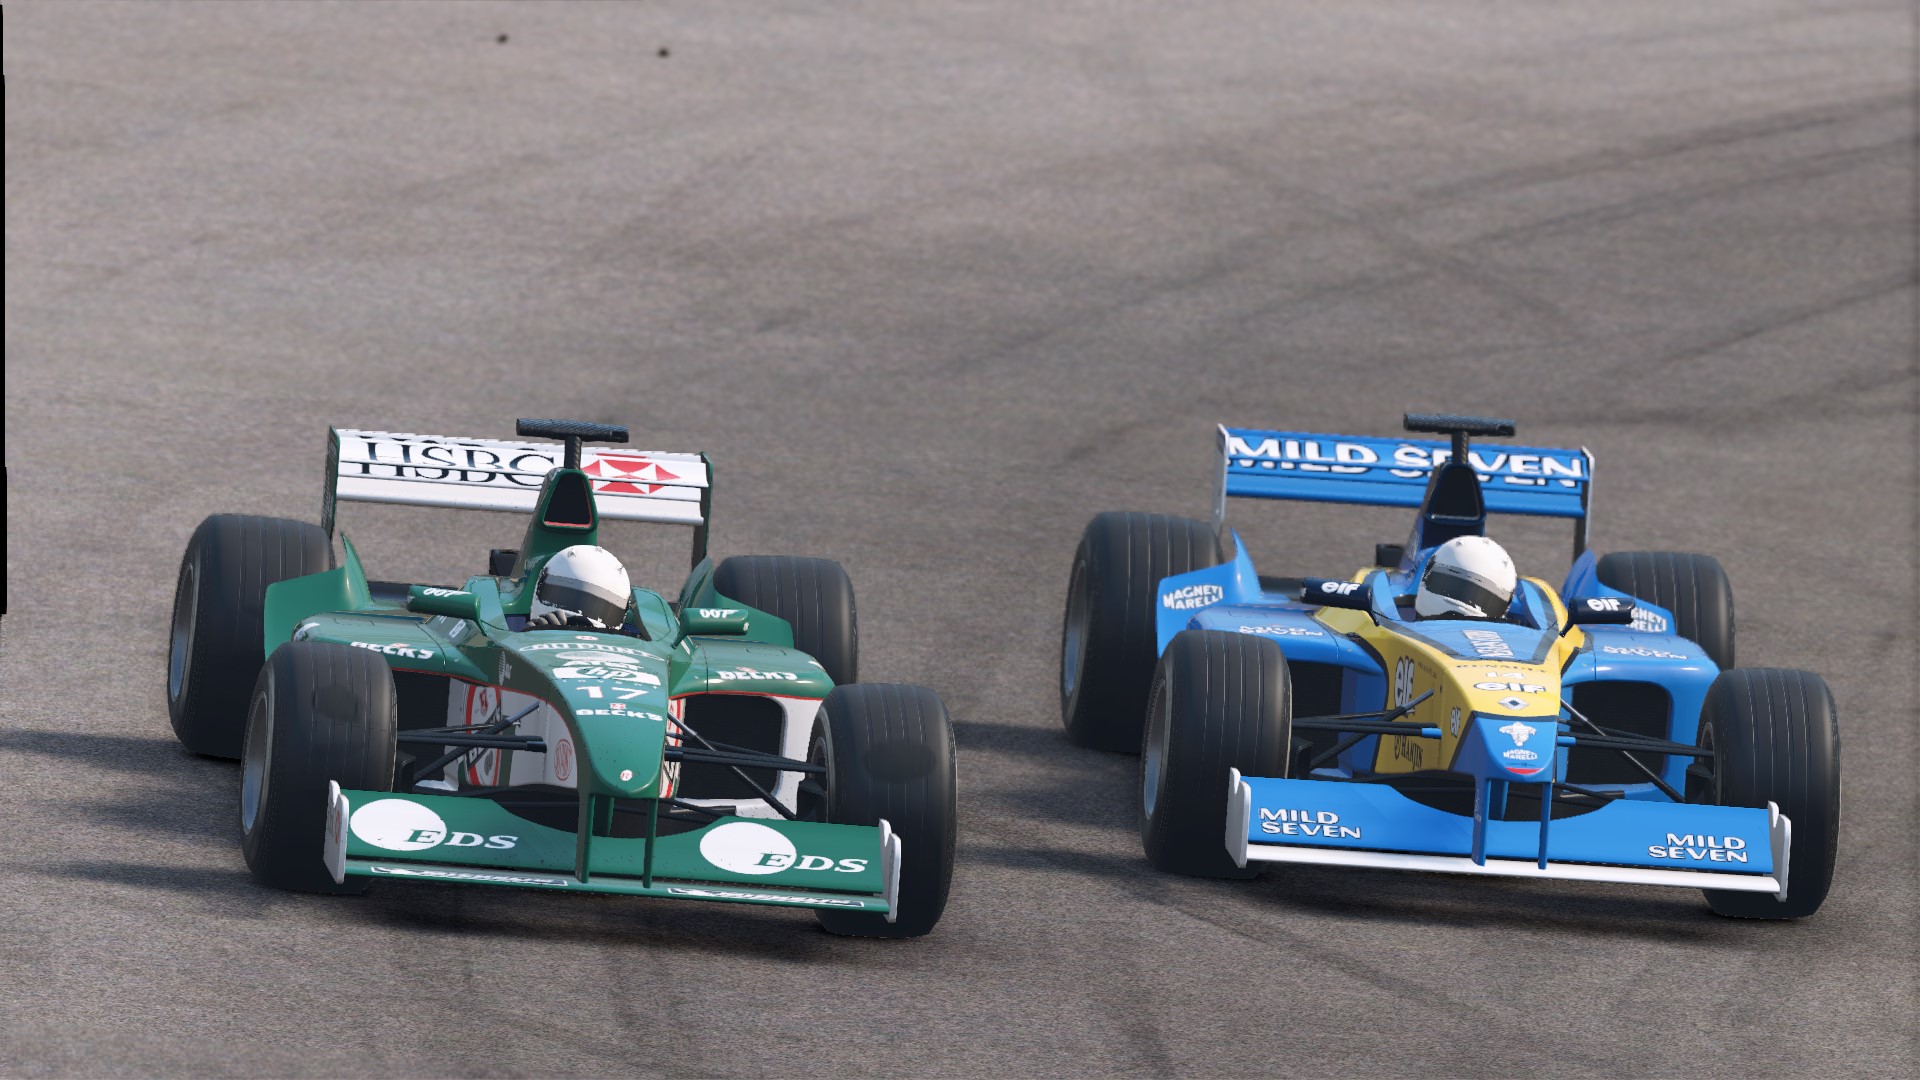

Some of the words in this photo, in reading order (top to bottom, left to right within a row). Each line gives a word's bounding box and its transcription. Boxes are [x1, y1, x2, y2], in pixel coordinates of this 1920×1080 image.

[1228, 436, 1379, 474] MILD
[1163, 585, 1223, 601] MAGNETI
[1321, 582, 1360, 596] elf
[1163, 593, 1223, 610] MARELLI
[1587, 598, 1621, 611] elf
[699, 608, 739, 619] 007
[1631, 607, 1667, 625] GNETI
[1627, 619, 1667, 633] RELLI
[576, 685, 649, 700] 17
[1258, 807, 1339, 825] MILD
[403, 828, 519, 850] EDS
[1261, 821, 1361, 839] SEVEN
[1666, 832, 1746, 850] MILD
[753, 851, 869, 874] EDS
[1648, 845, 1748, 863] SEVEN
